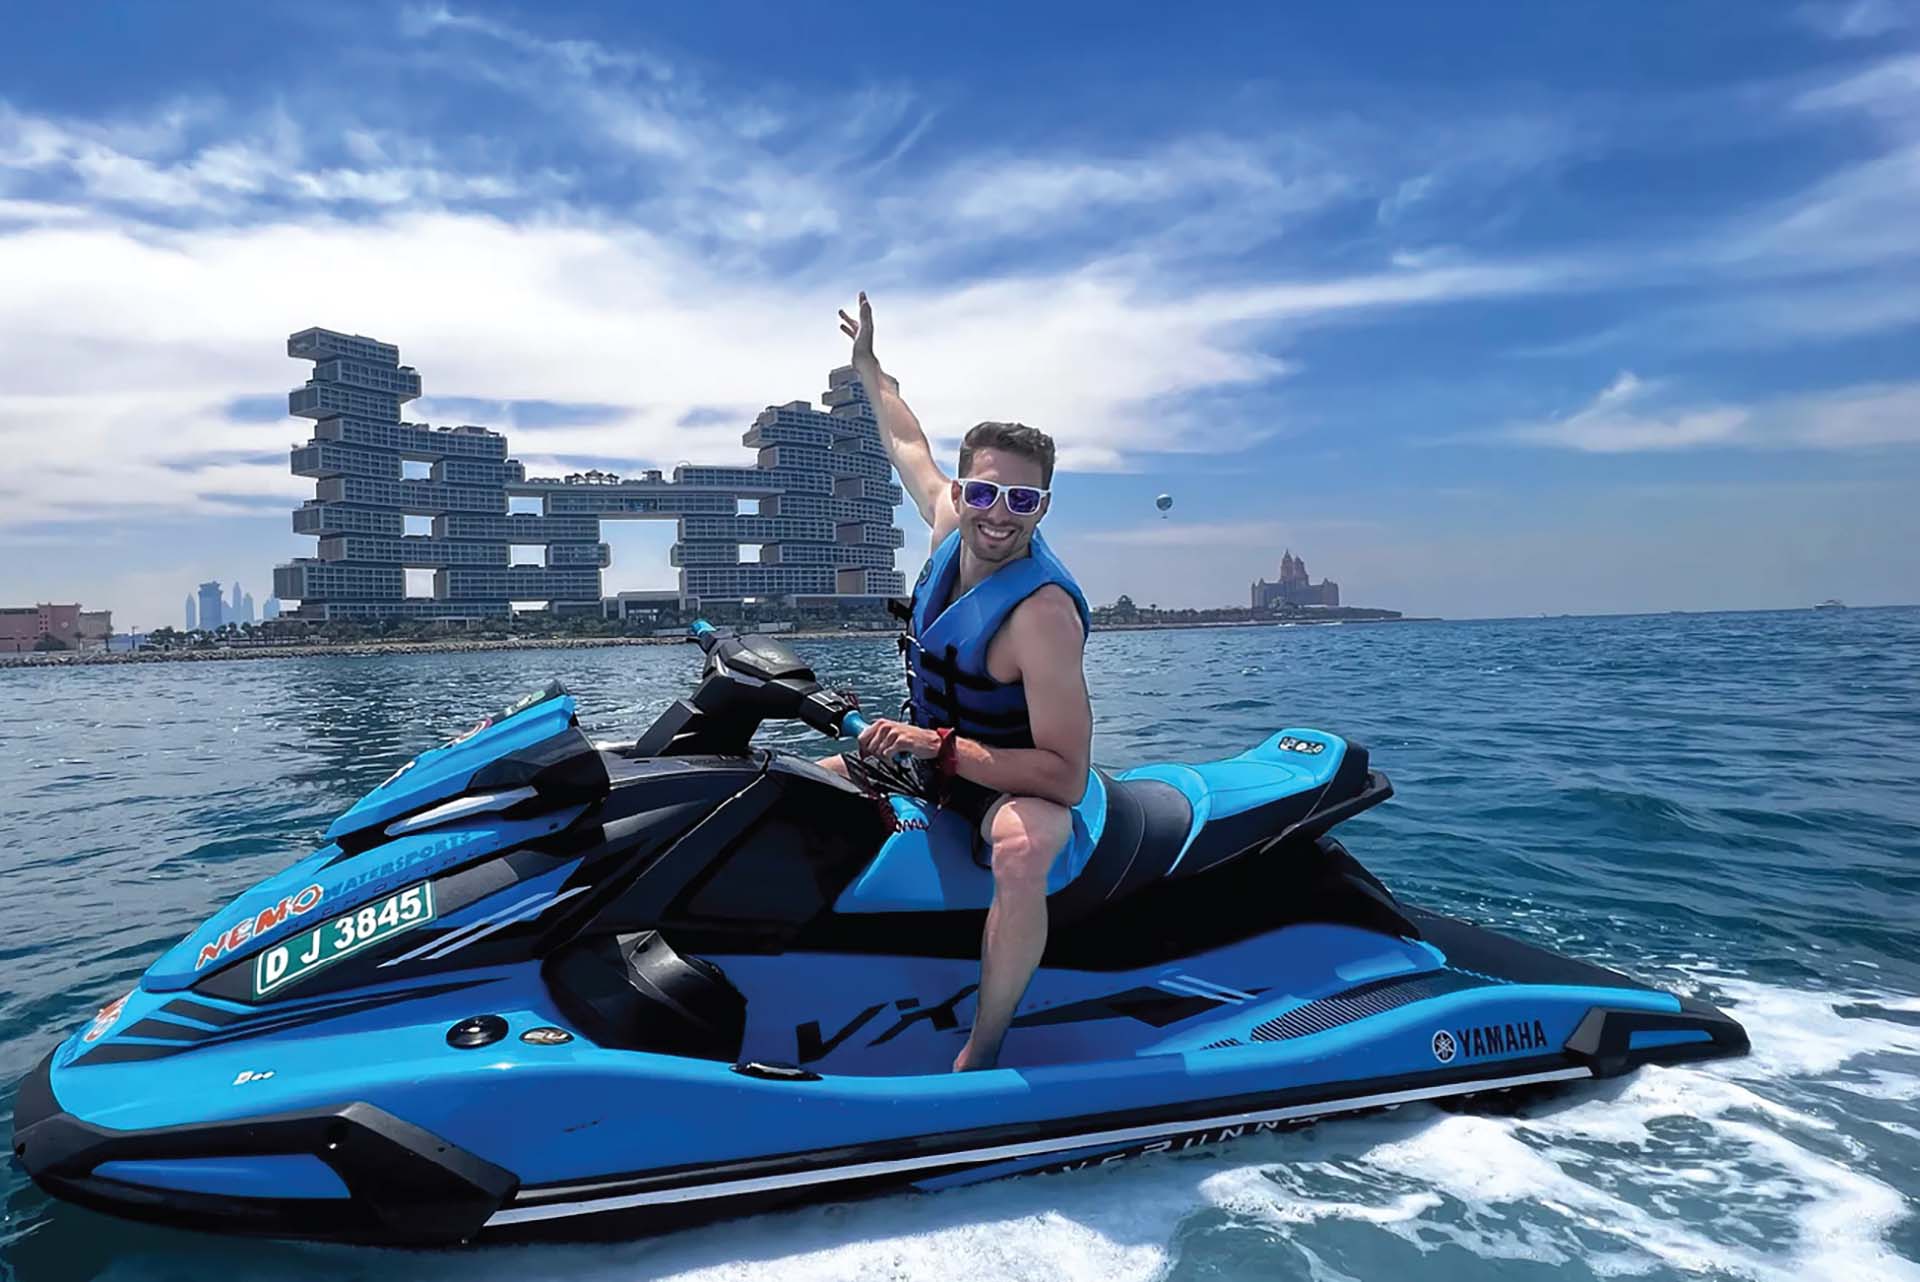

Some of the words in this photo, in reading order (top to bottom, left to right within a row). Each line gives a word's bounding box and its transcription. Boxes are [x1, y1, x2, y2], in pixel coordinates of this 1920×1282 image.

[195, 883, 324, 970] NEMO
[322, 831, 474, 901] WATERSPORTS
[265, 946, 288, 983] D
[300, 927, 321, 963] J
[333, 887, 422, 949] 3845
[1456, 1019, 1548, 1058] YAMAHA
